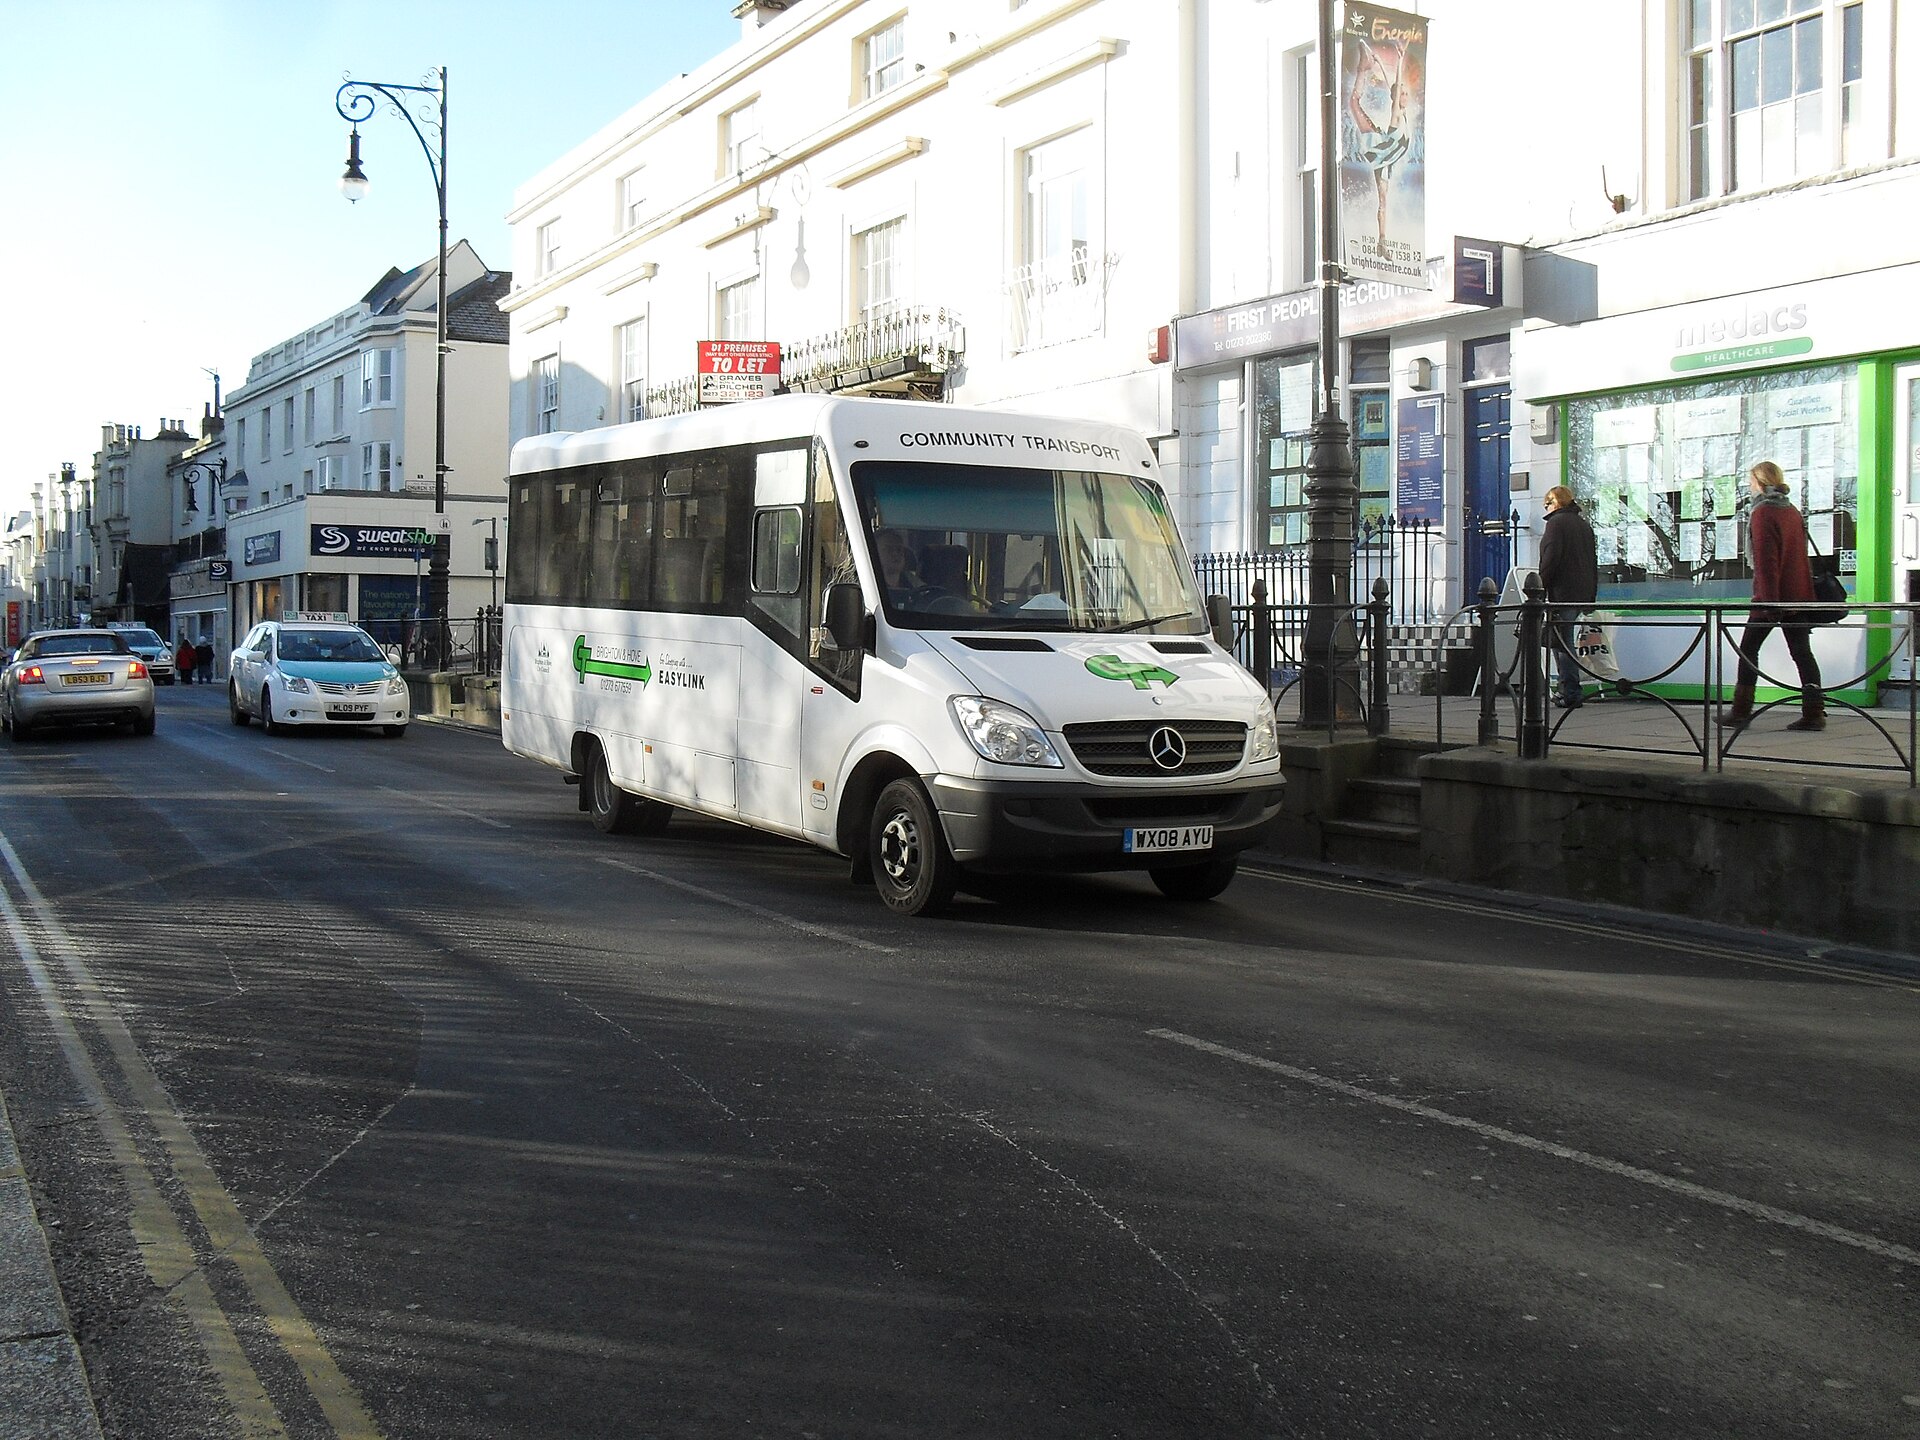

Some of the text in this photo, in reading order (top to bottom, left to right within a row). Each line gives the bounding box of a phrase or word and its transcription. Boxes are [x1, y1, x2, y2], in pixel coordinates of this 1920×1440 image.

[1371, 17, 1424, 46] Energia
[1362, 244, 1382, 257] 084
[1395, 251, 1410, 262] 1538
[1351, 254, 1422, 278] brightoncentre.co.uk
[1228, 306, 1266, 333] FIRST
[1272, 294, 1319, 324] PEOPL
[1676, 302, 1807, 348] medacs
[724, 343, 768, 353] PREMISES
[1226, 337, 1244, 350] 01273
[1704, 345, 1775, 363] HEALTHCARE
[712, 357, 767, 373] TO LET
[1776, 406, 1833, 418] Social Workers
[900, 432, 1121, 461] COMMUNITY TRANSPORT
[596, 645, 622, 660] BRIGHTON
[626, 649, 642, 663] HOVE
[1576, 644, 1608, 656] OPS
[659, 670, 704, 690] EASYLINK
[1136, 828, 1211, 848] WX08 AYU
